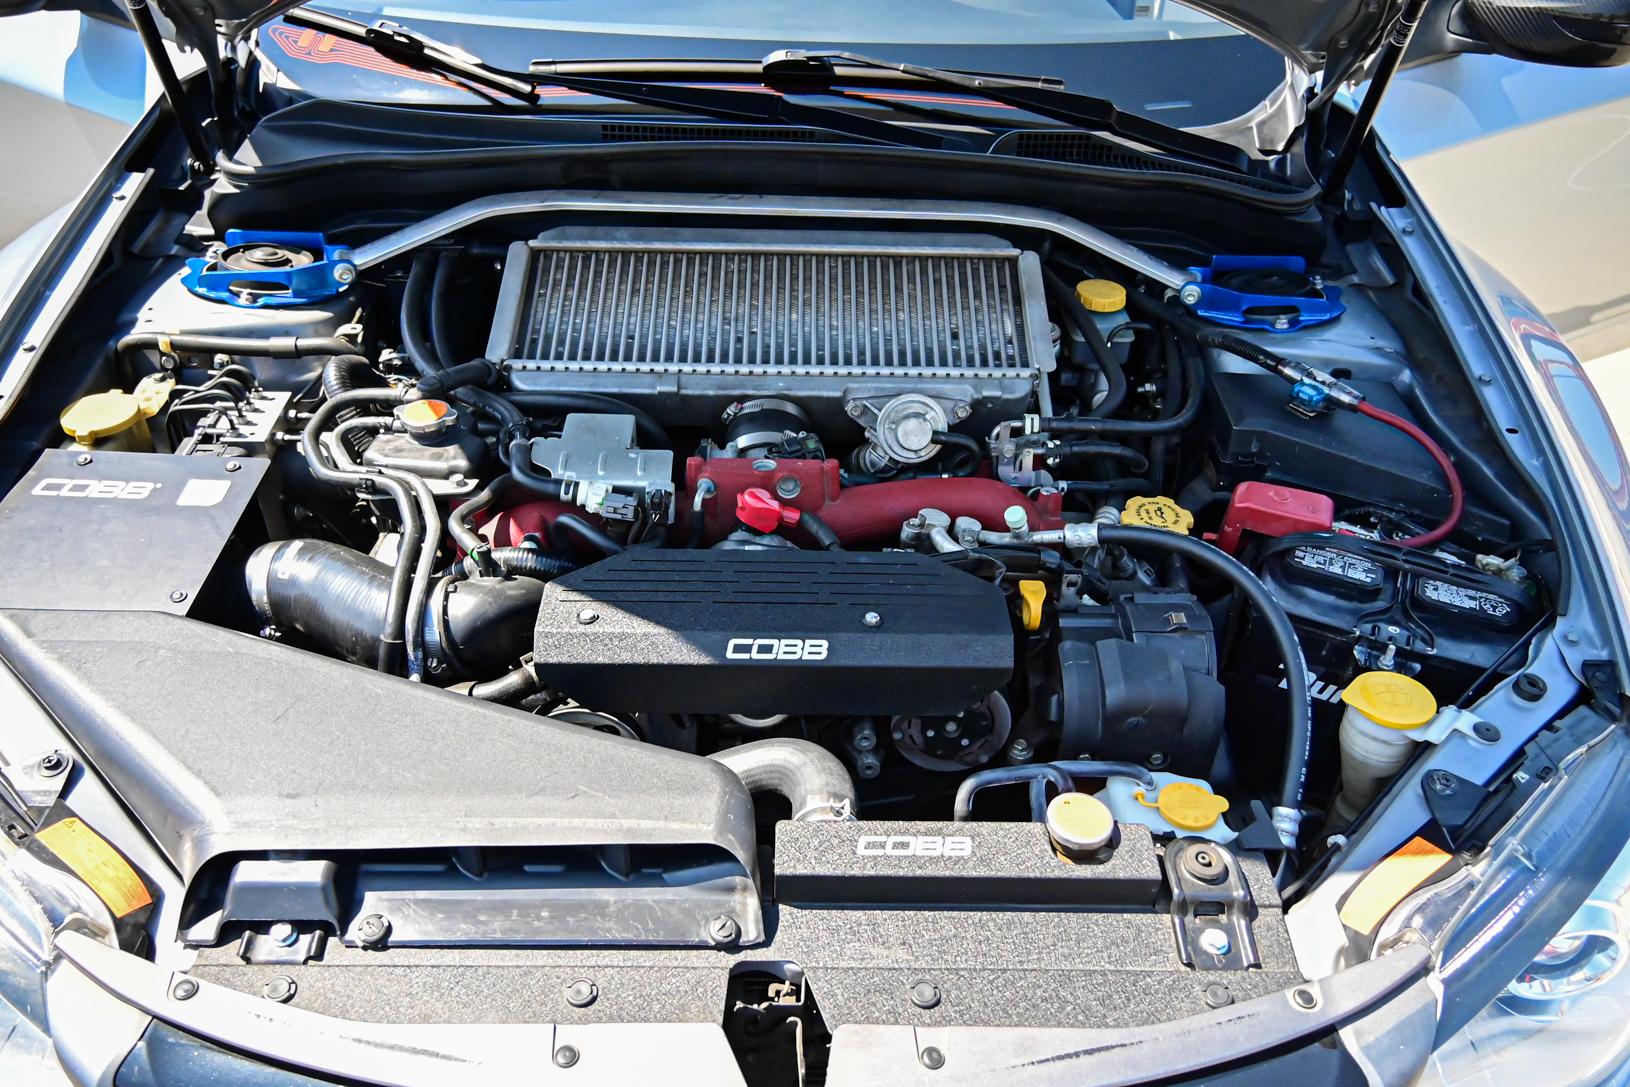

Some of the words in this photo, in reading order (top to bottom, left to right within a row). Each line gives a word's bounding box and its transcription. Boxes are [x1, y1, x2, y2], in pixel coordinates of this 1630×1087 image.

[31, 478, 155, 499] COBB
[725, 638, 829, 660] COBB
[856, 835, 973, 856] COBB
